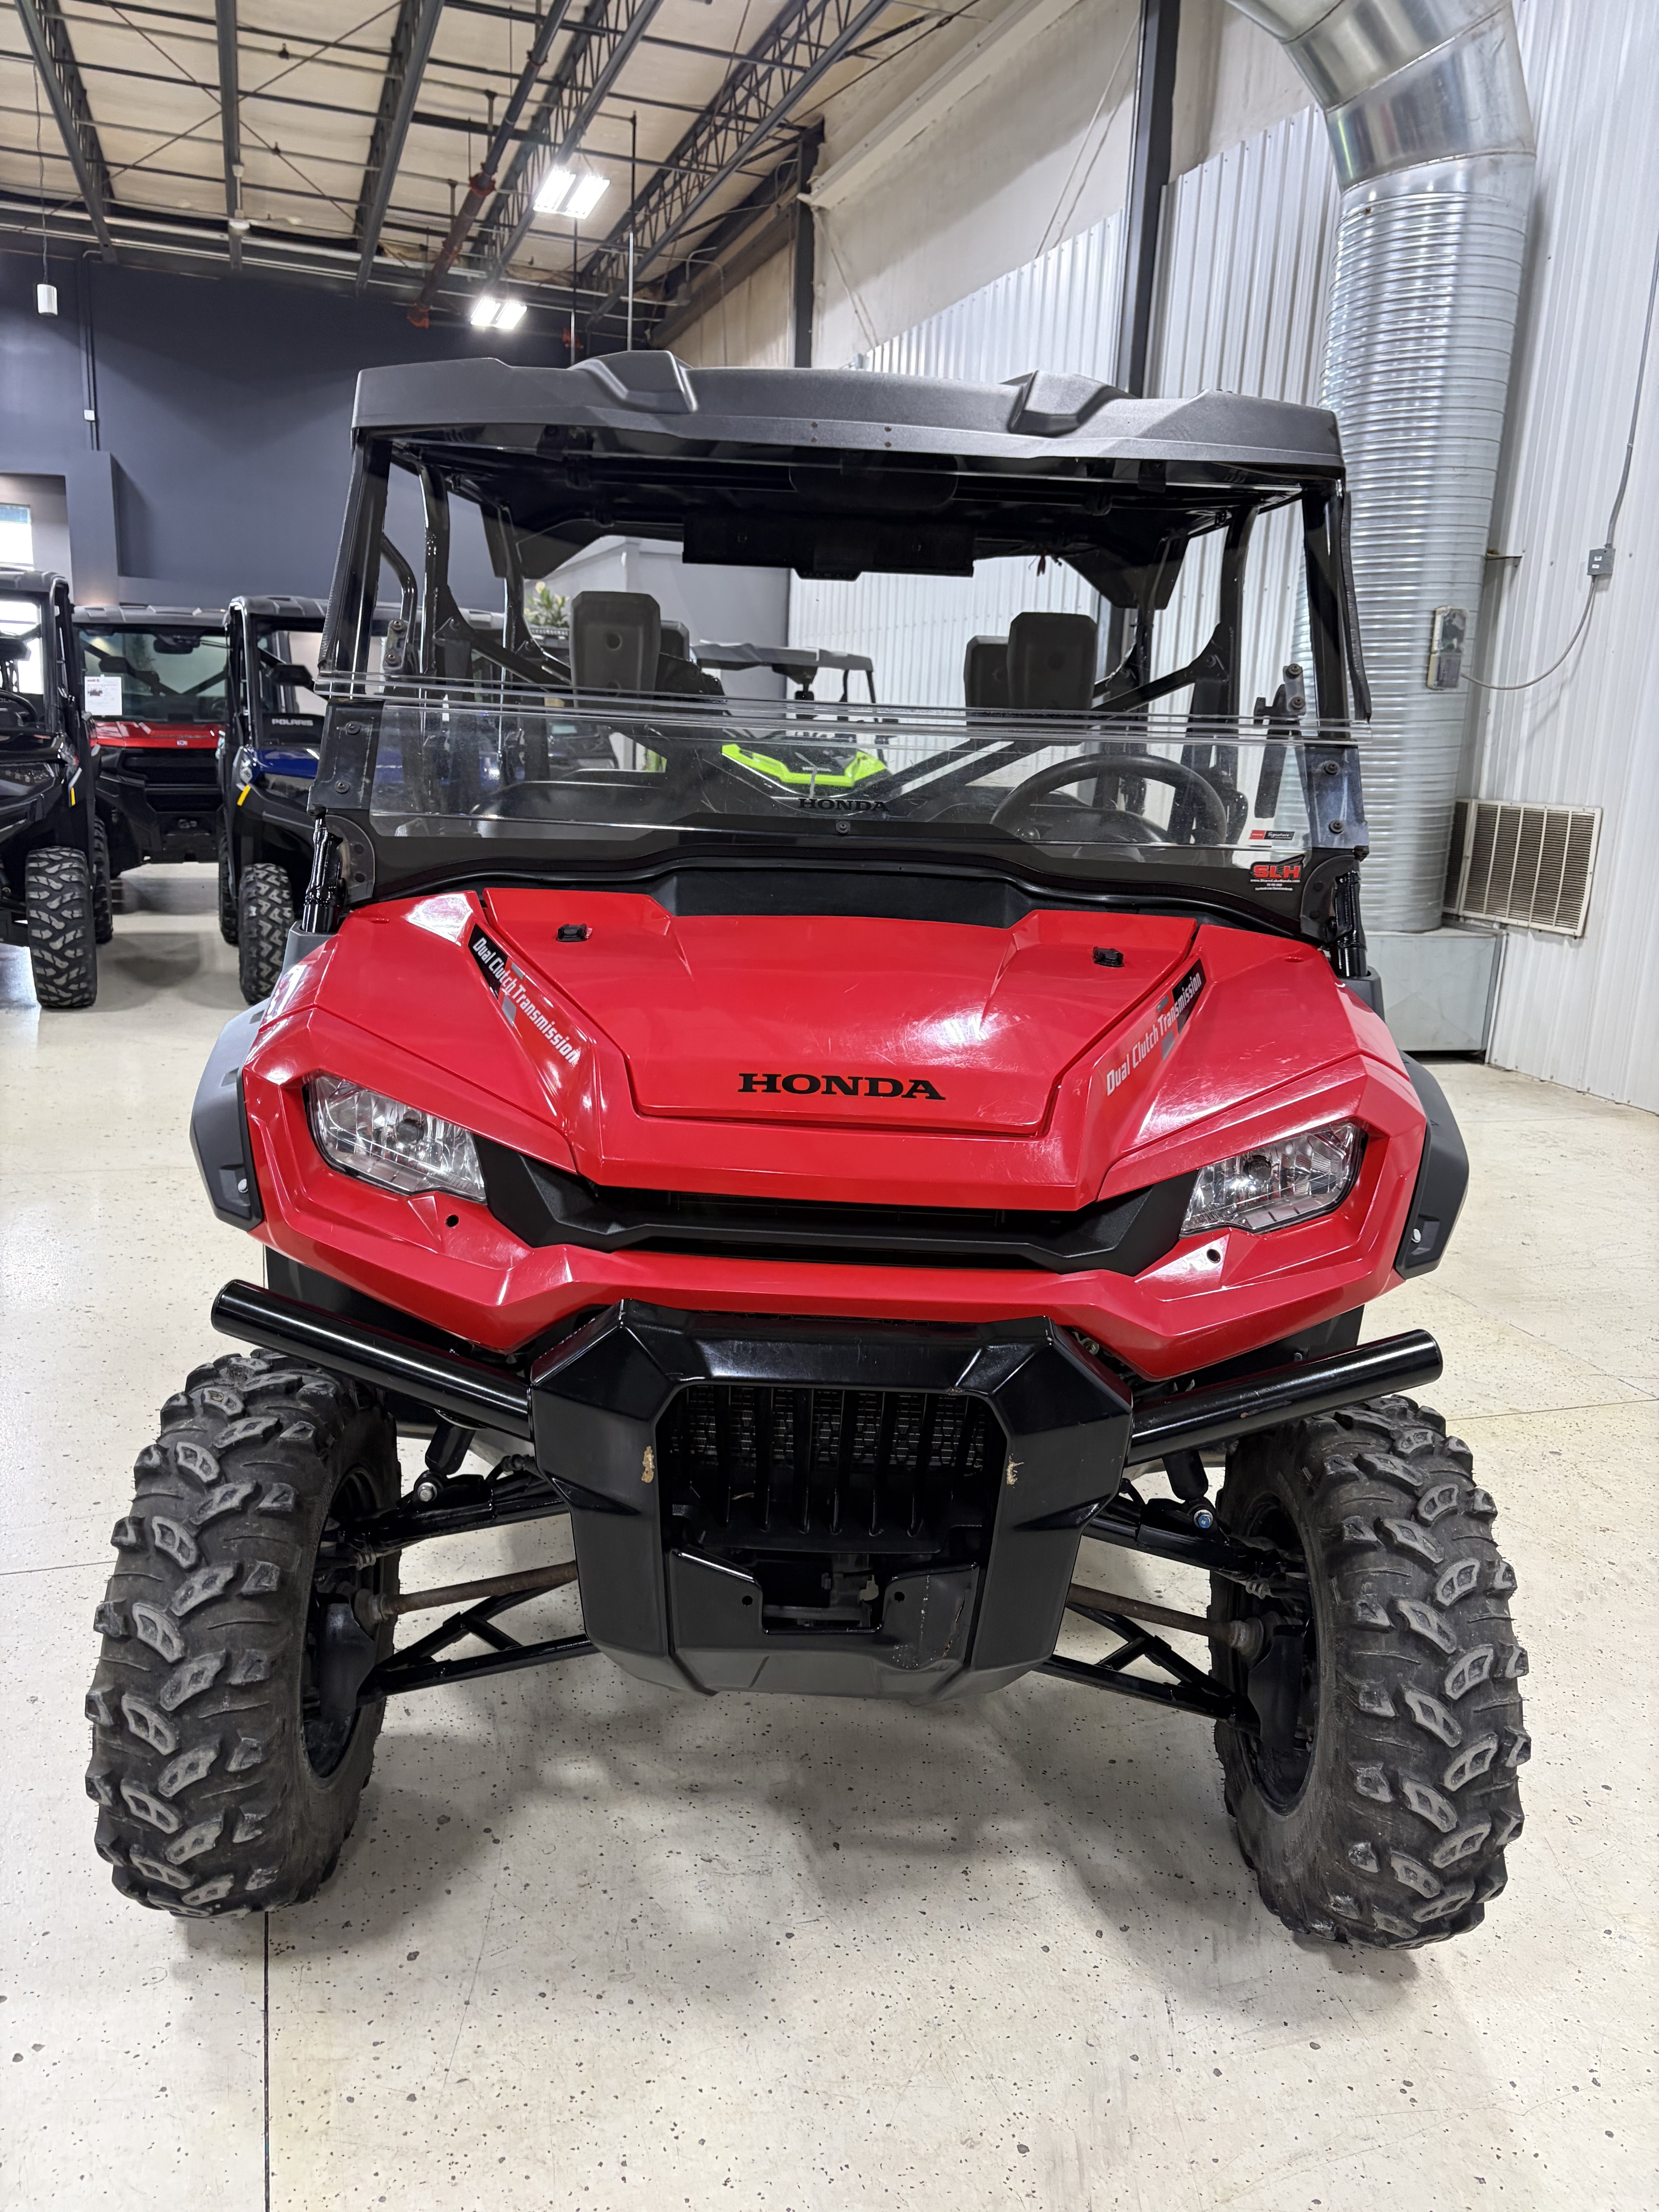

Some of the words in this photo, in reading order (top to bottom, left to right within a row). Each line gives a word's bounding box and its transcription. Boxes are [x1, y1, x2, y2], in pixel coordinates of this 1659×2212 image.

[798, 798, 889, 811] HONDA
[1253, 865, 1301, 879] SLH
[472, 937, 496, 963] Dual
[489, 957, 517, 995] Clutch
[512, 984, 580, 1065] Transmission
[1106, 1053, 1130, 1096] Dual
[1132, 1024, 1159, 1069] Clutch
[1157, 972, 1202, 1036] Transmission
[738, 1073, 946, 1100] HONDA
